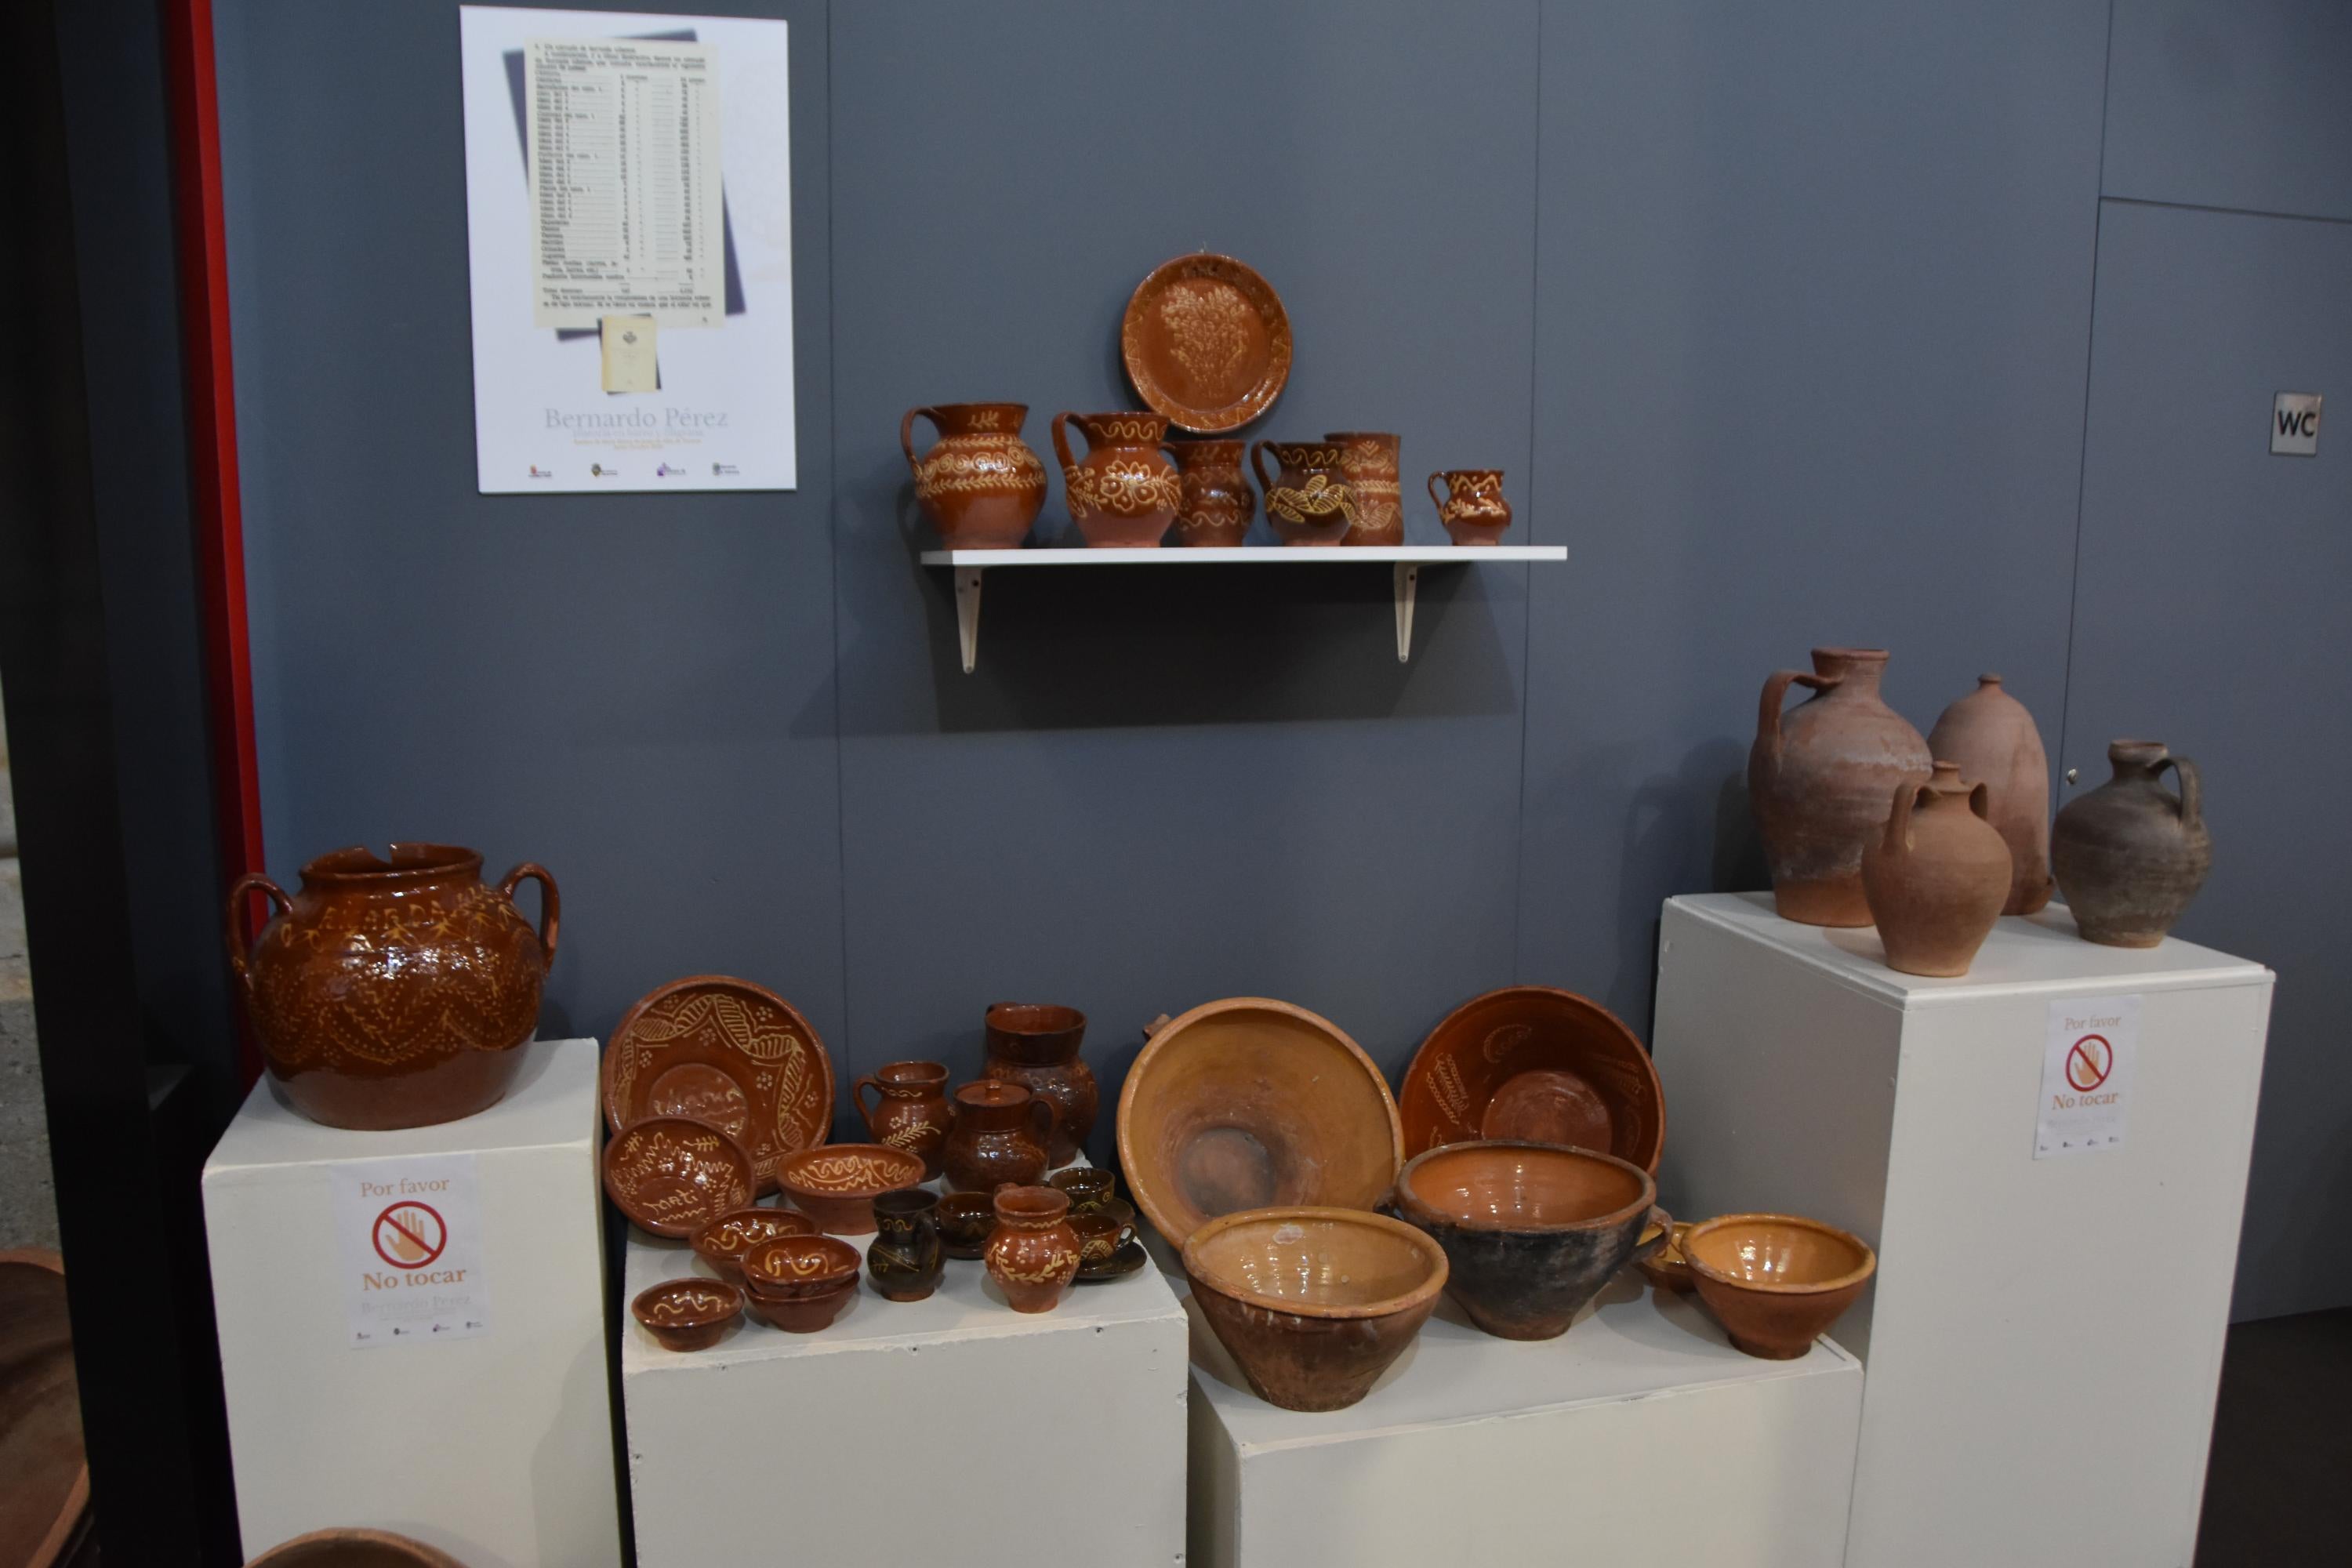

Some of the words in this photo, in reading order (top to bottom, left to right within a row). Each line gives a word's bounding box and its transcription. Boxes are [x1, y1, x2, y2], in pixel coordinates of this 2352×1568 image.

[545, 407, 657, 428] Bernardo
[666, 406, 728, 427] Pérez
[2278, 410, 2316, 437] WC
[2064, 1017, 2085, 1031] Por
[2089, 1014, 2122, 1029] favor
[2052, 1094, 2075, 1110] No
[2079, 1092, 2119, 1107] tocar
[360, 1181, 394, 1197] Por
[400, 1178, 450, 1194] favor
[362, 1272, 398, 1291] No
[405, 1269, 466, 1287] tocar
